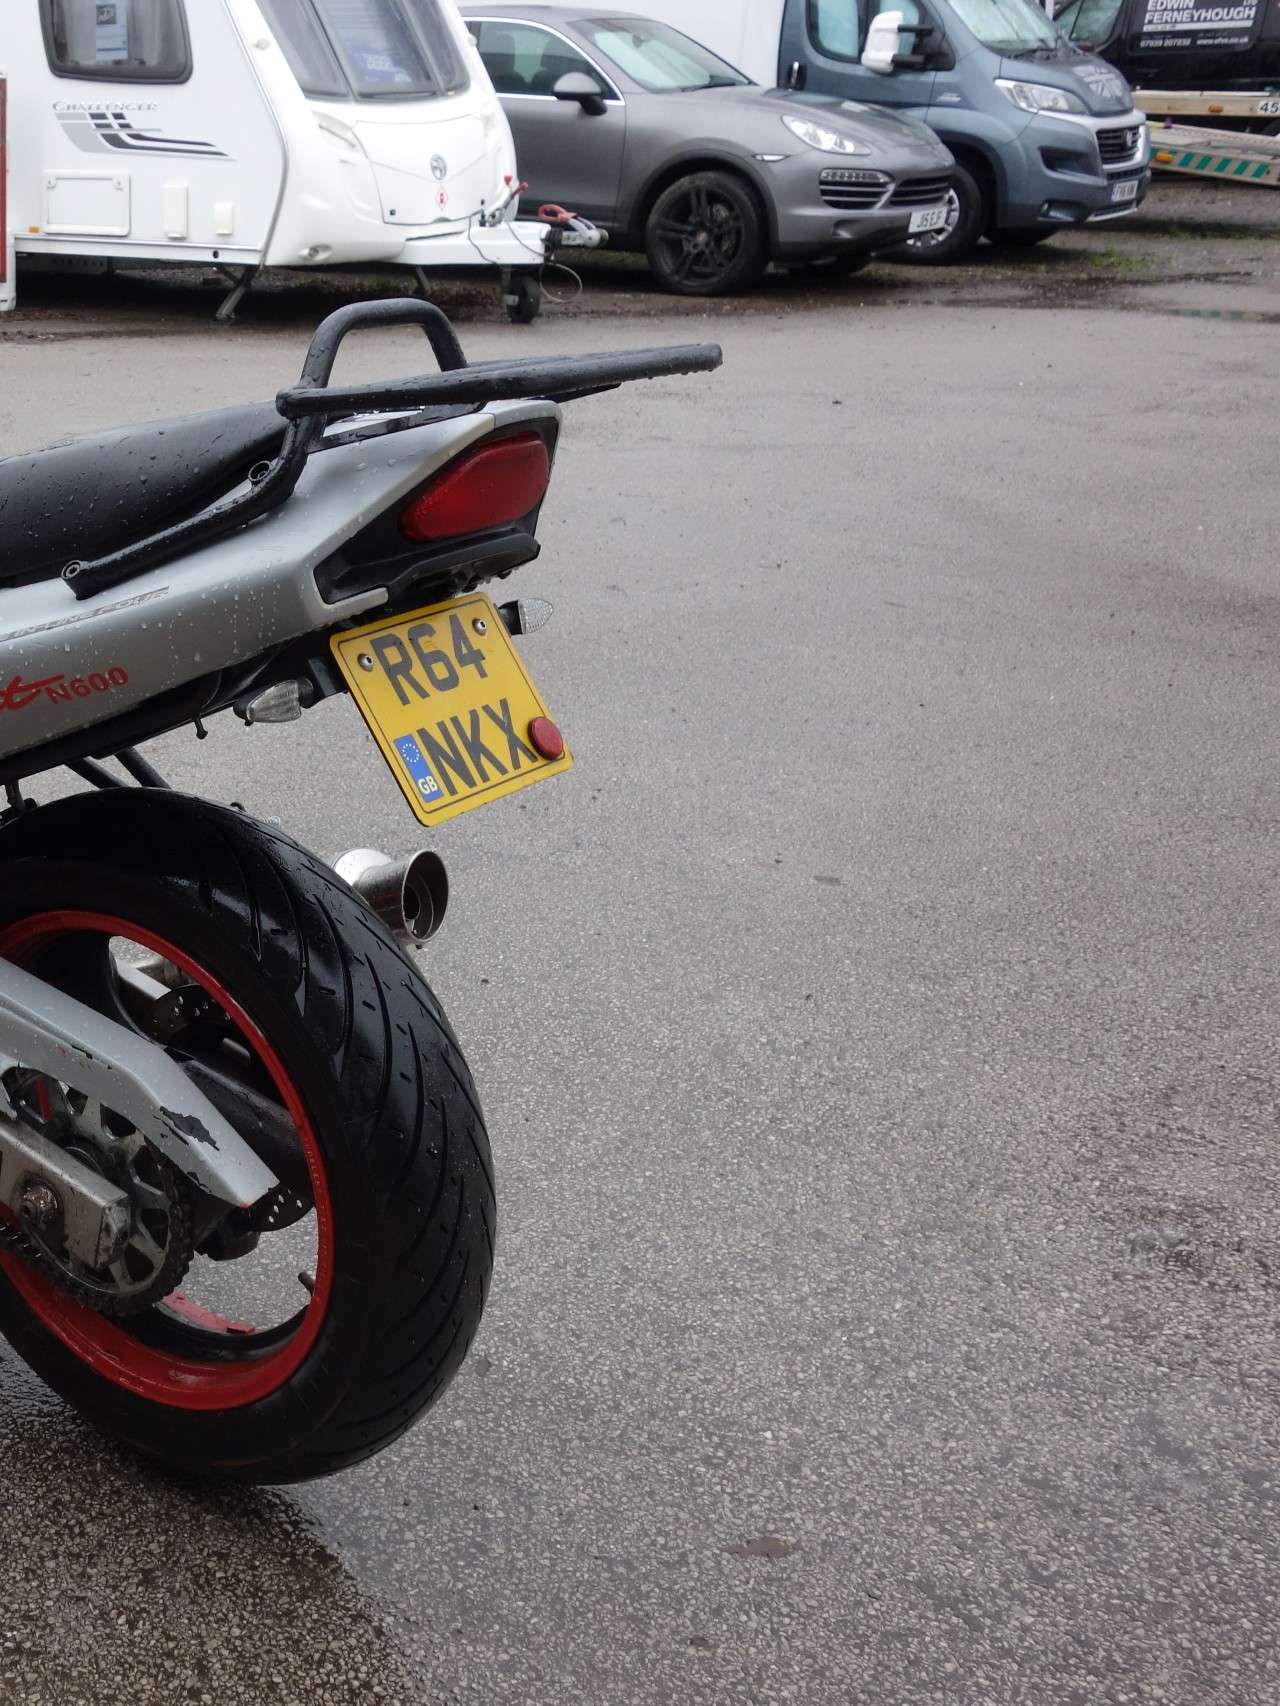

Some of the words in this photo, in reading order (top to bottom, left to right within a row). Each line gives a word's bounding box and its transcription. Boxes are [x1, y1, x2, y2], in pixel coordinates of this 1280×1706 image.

[1144, 6, 1257, 24] FERNEYHOUGH
[1147, 0, 1195, 11] EDWIN
[52, 101, 159, 112] CHALLENGER
[370, 614, 488, 706] R64
[45, 666, 129, 704] N600
[417, 697, 538, 796] NKX
[417, 775, 439, 795] GB
